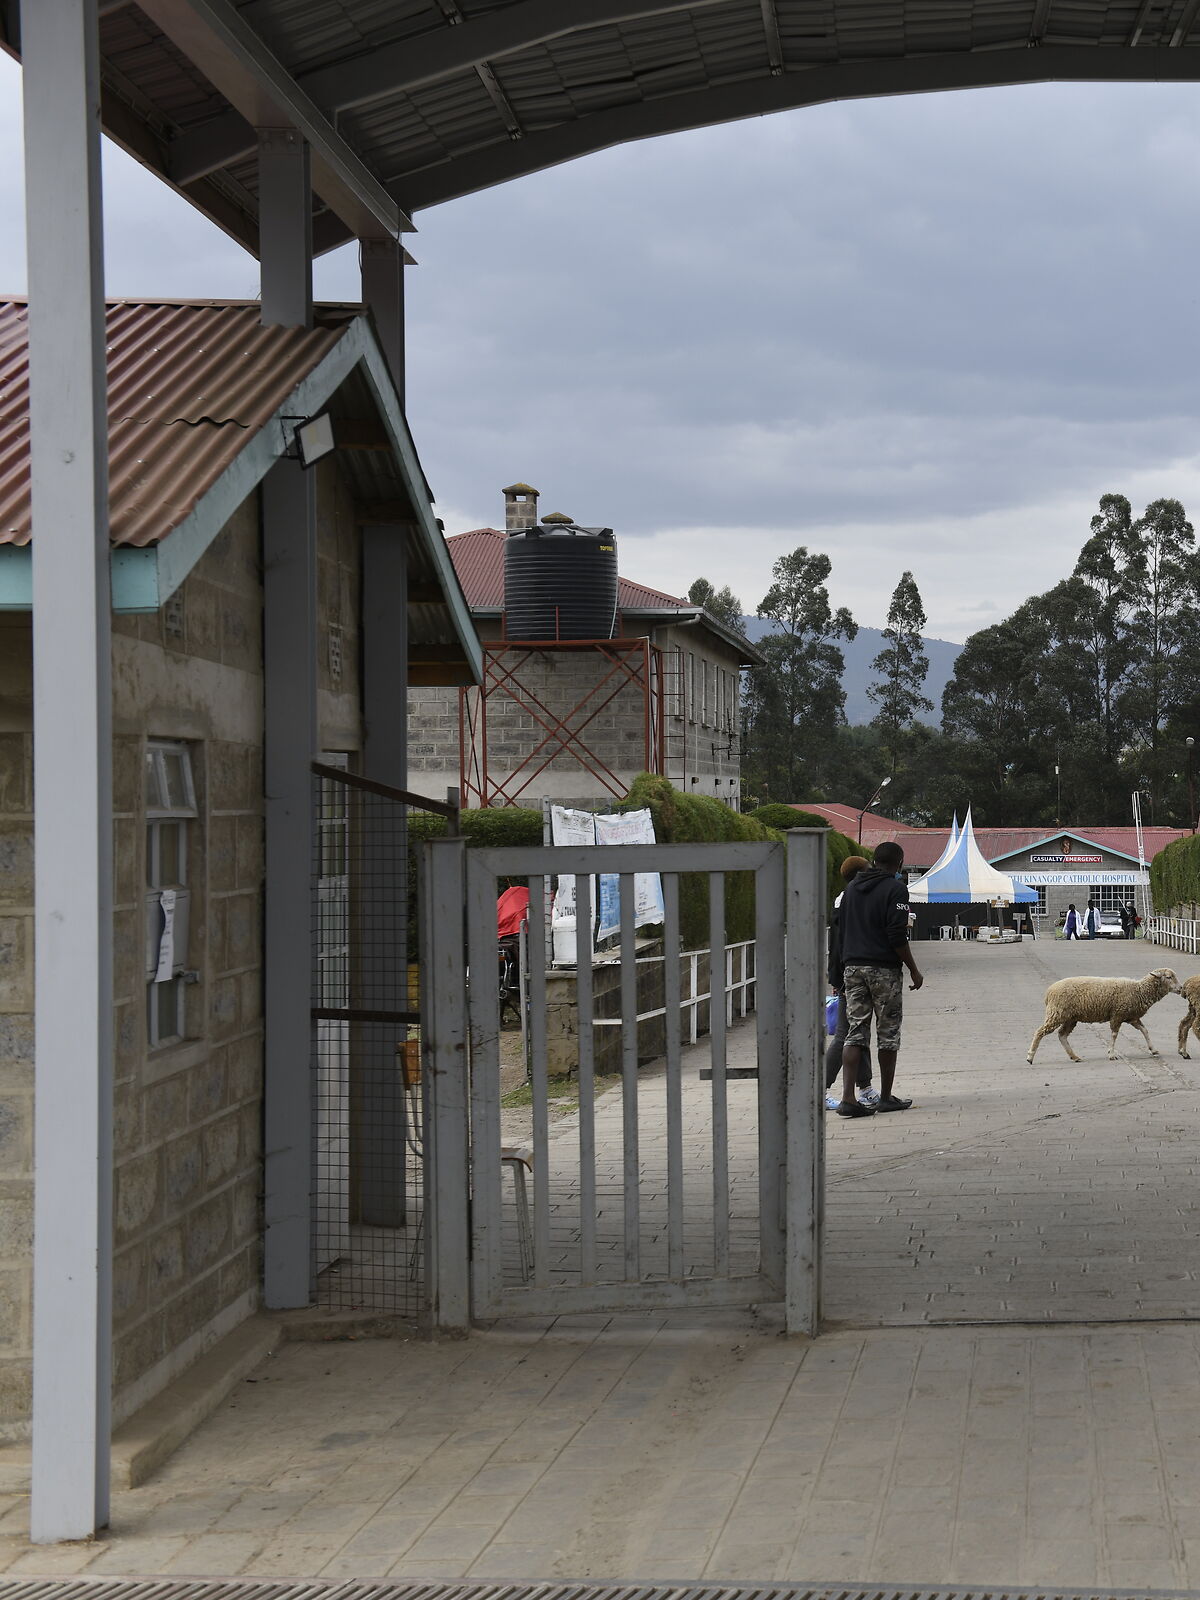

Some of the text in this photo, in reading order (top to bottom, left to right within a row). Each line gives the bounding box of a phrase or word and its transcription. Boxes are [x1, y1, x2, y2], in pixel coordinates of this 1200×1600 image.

[1024, 874, 1061, 883] KINANGOP
[1062, 874, 1101, 883] CATHOLIC
[1102, 874, 1138, 883] HOSPITAL
